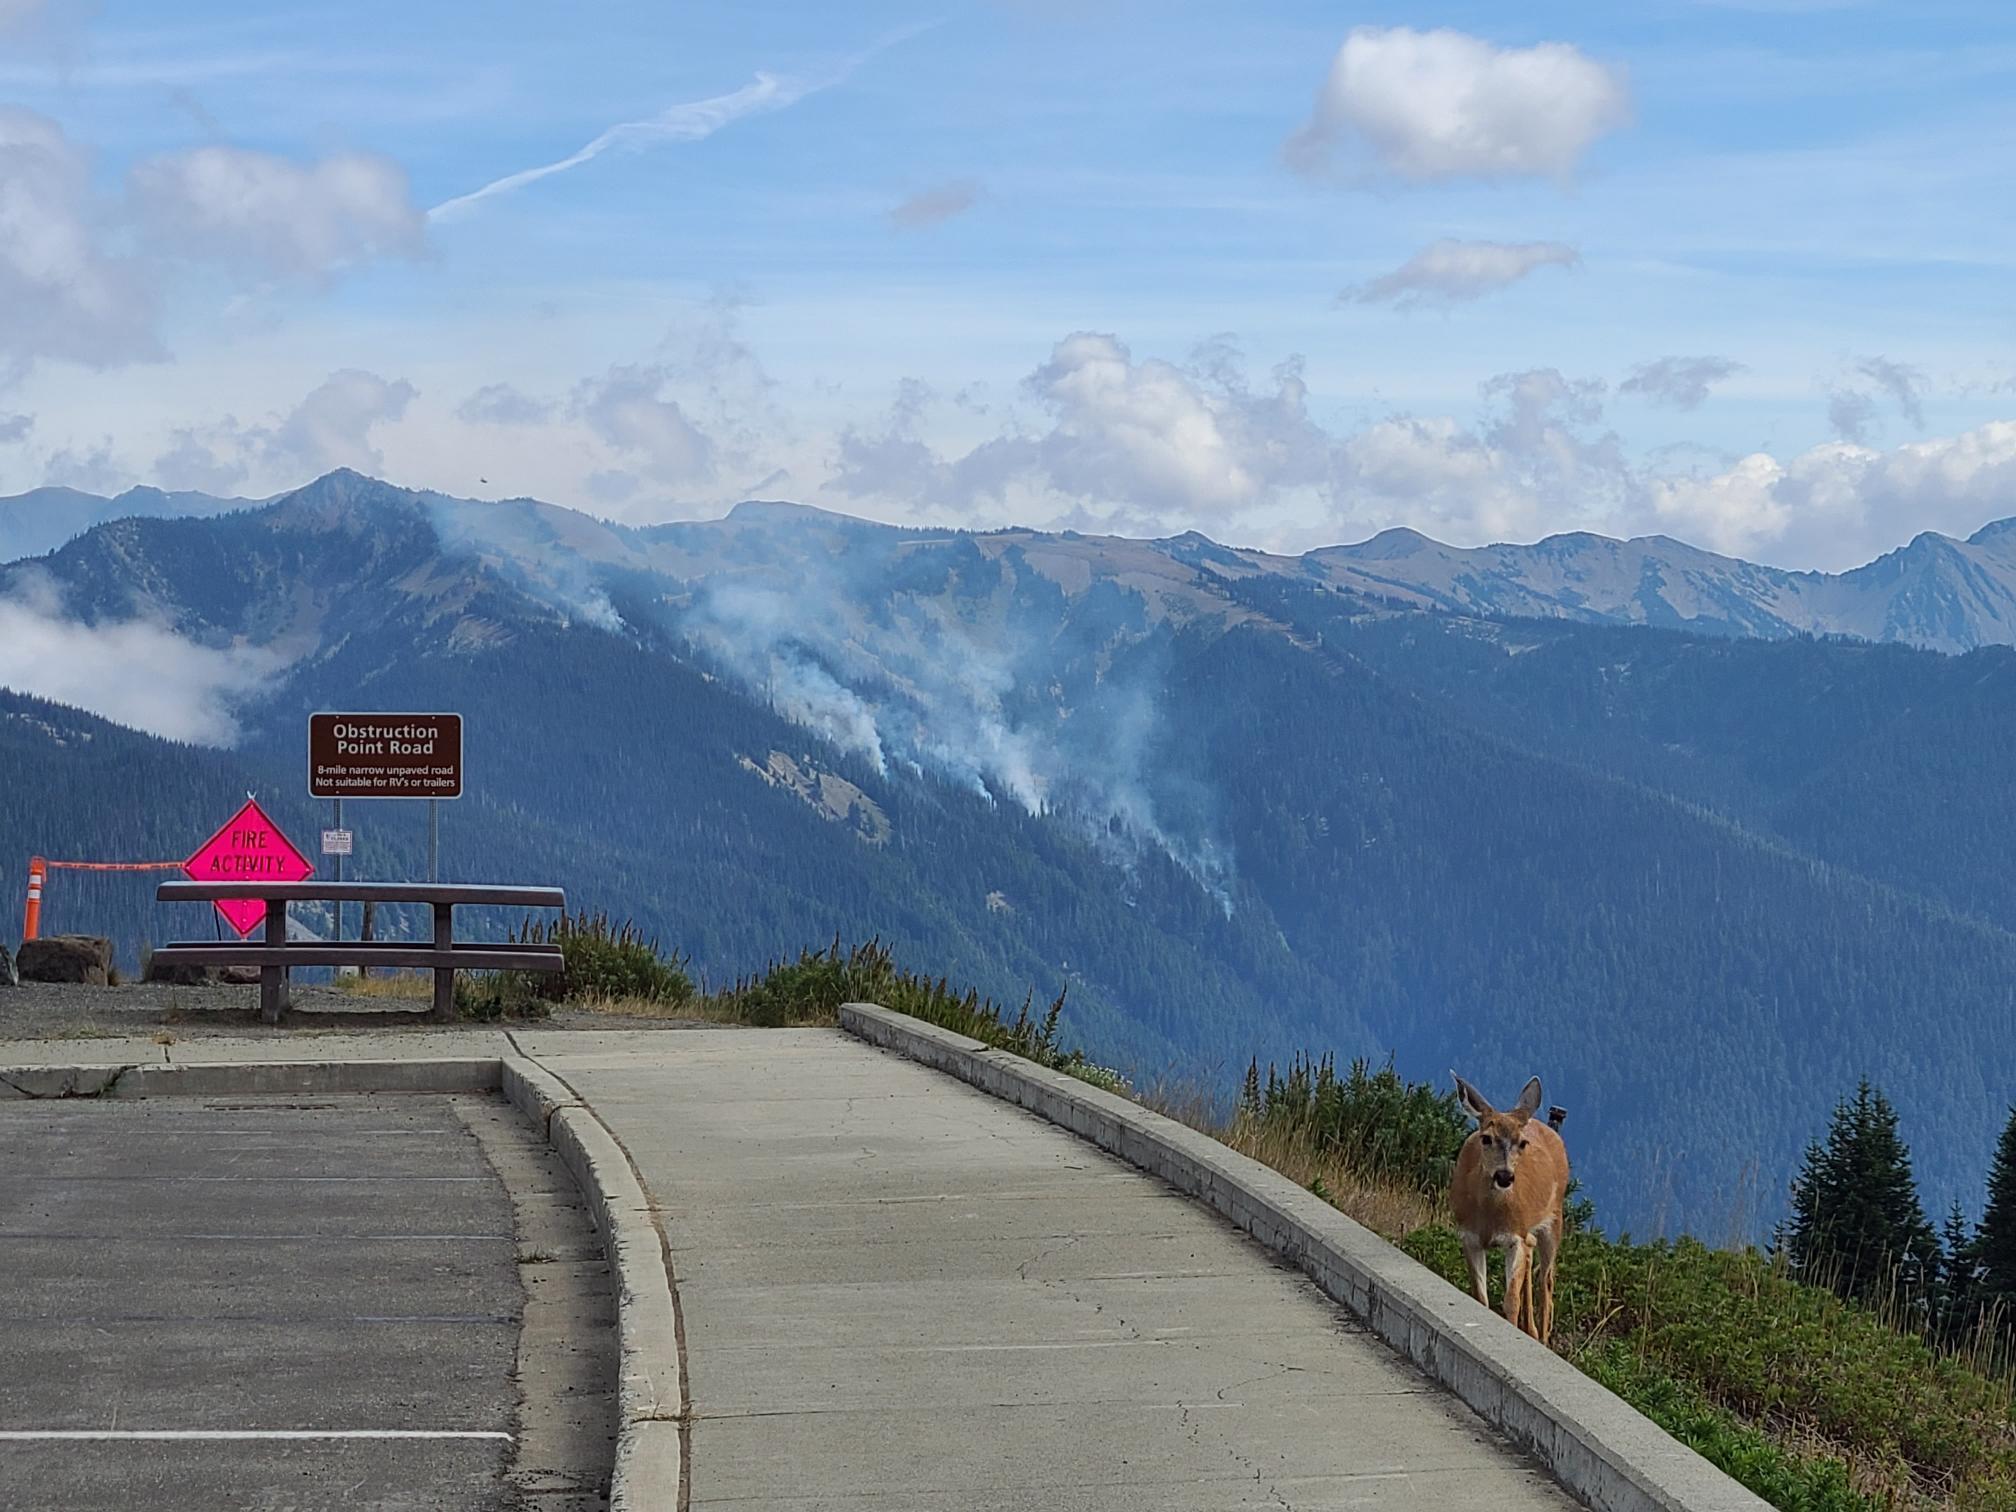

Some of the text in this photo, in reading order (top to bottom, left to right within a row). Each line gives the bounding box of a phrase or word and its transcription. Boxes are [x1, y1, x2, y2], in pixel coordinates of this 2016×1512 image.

[333, 724, 438, 738] Obstruction
[337, 740, 433, 755] Point Road
[317, 764, 454, 777] 8-mile narrow unpaved road
[315, 777, 456, 788] Not suitable for RV's or trailers
[232, 831, 268, 848] FIRE
[211, 856, 285, 872] ACTIVITY
